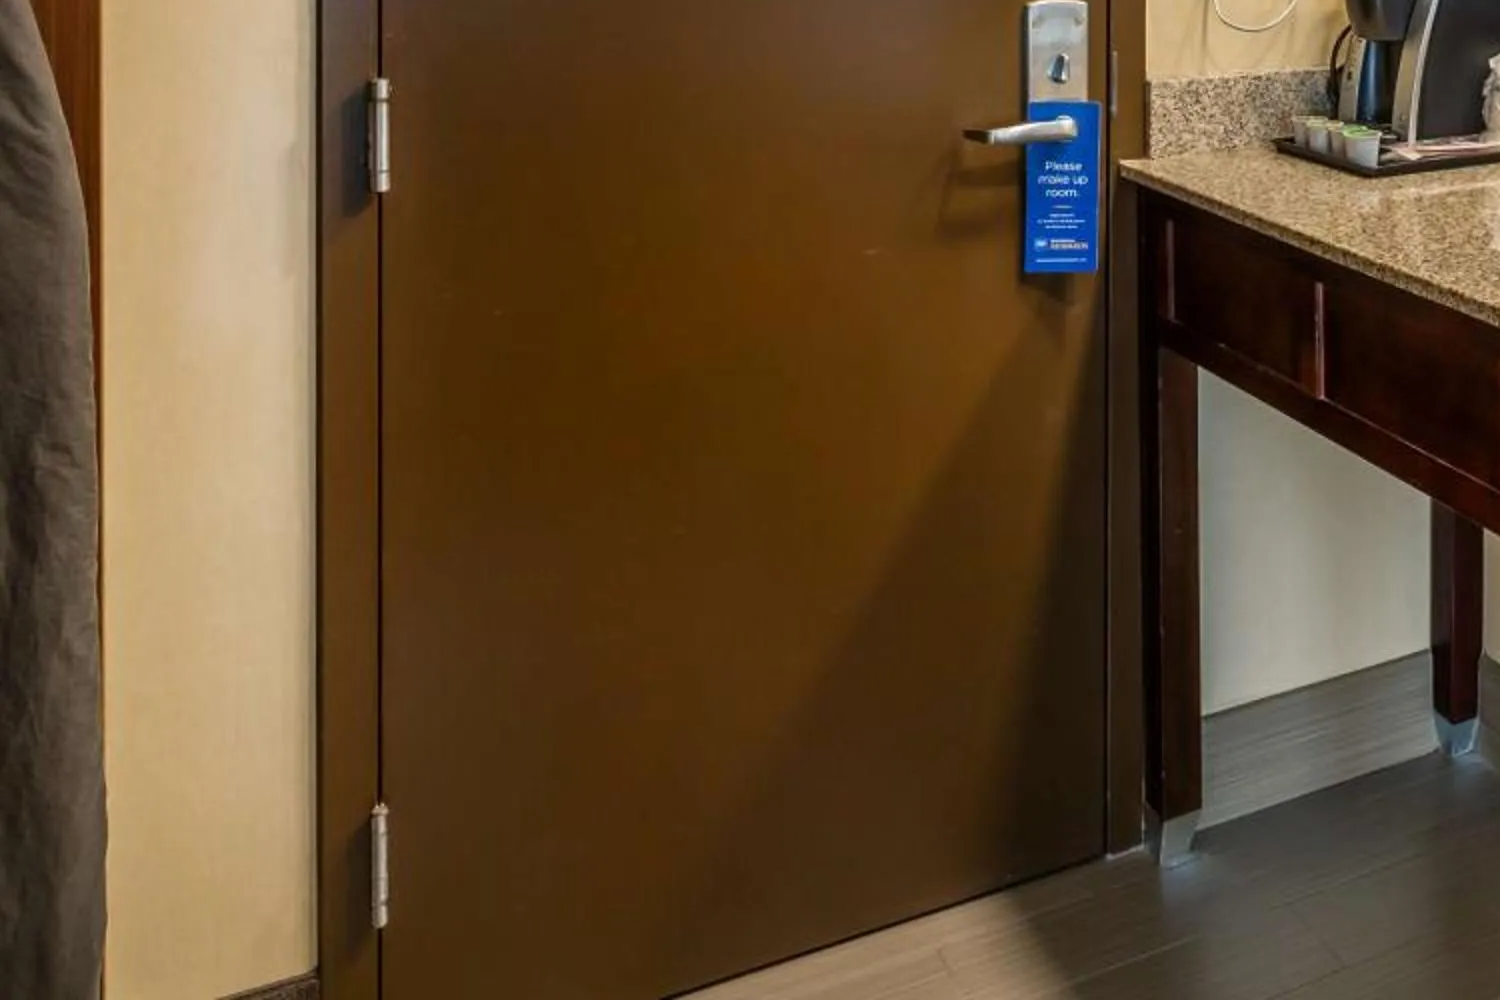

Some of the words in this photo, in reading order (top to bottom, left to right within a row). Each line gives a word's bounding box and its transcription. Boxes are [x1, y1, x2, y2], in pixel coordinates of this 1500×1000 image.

[1044, 161, 1083, 172] Please
[1037, 174, 1070, 185] make
[1072, 176, 1089, 186] up
